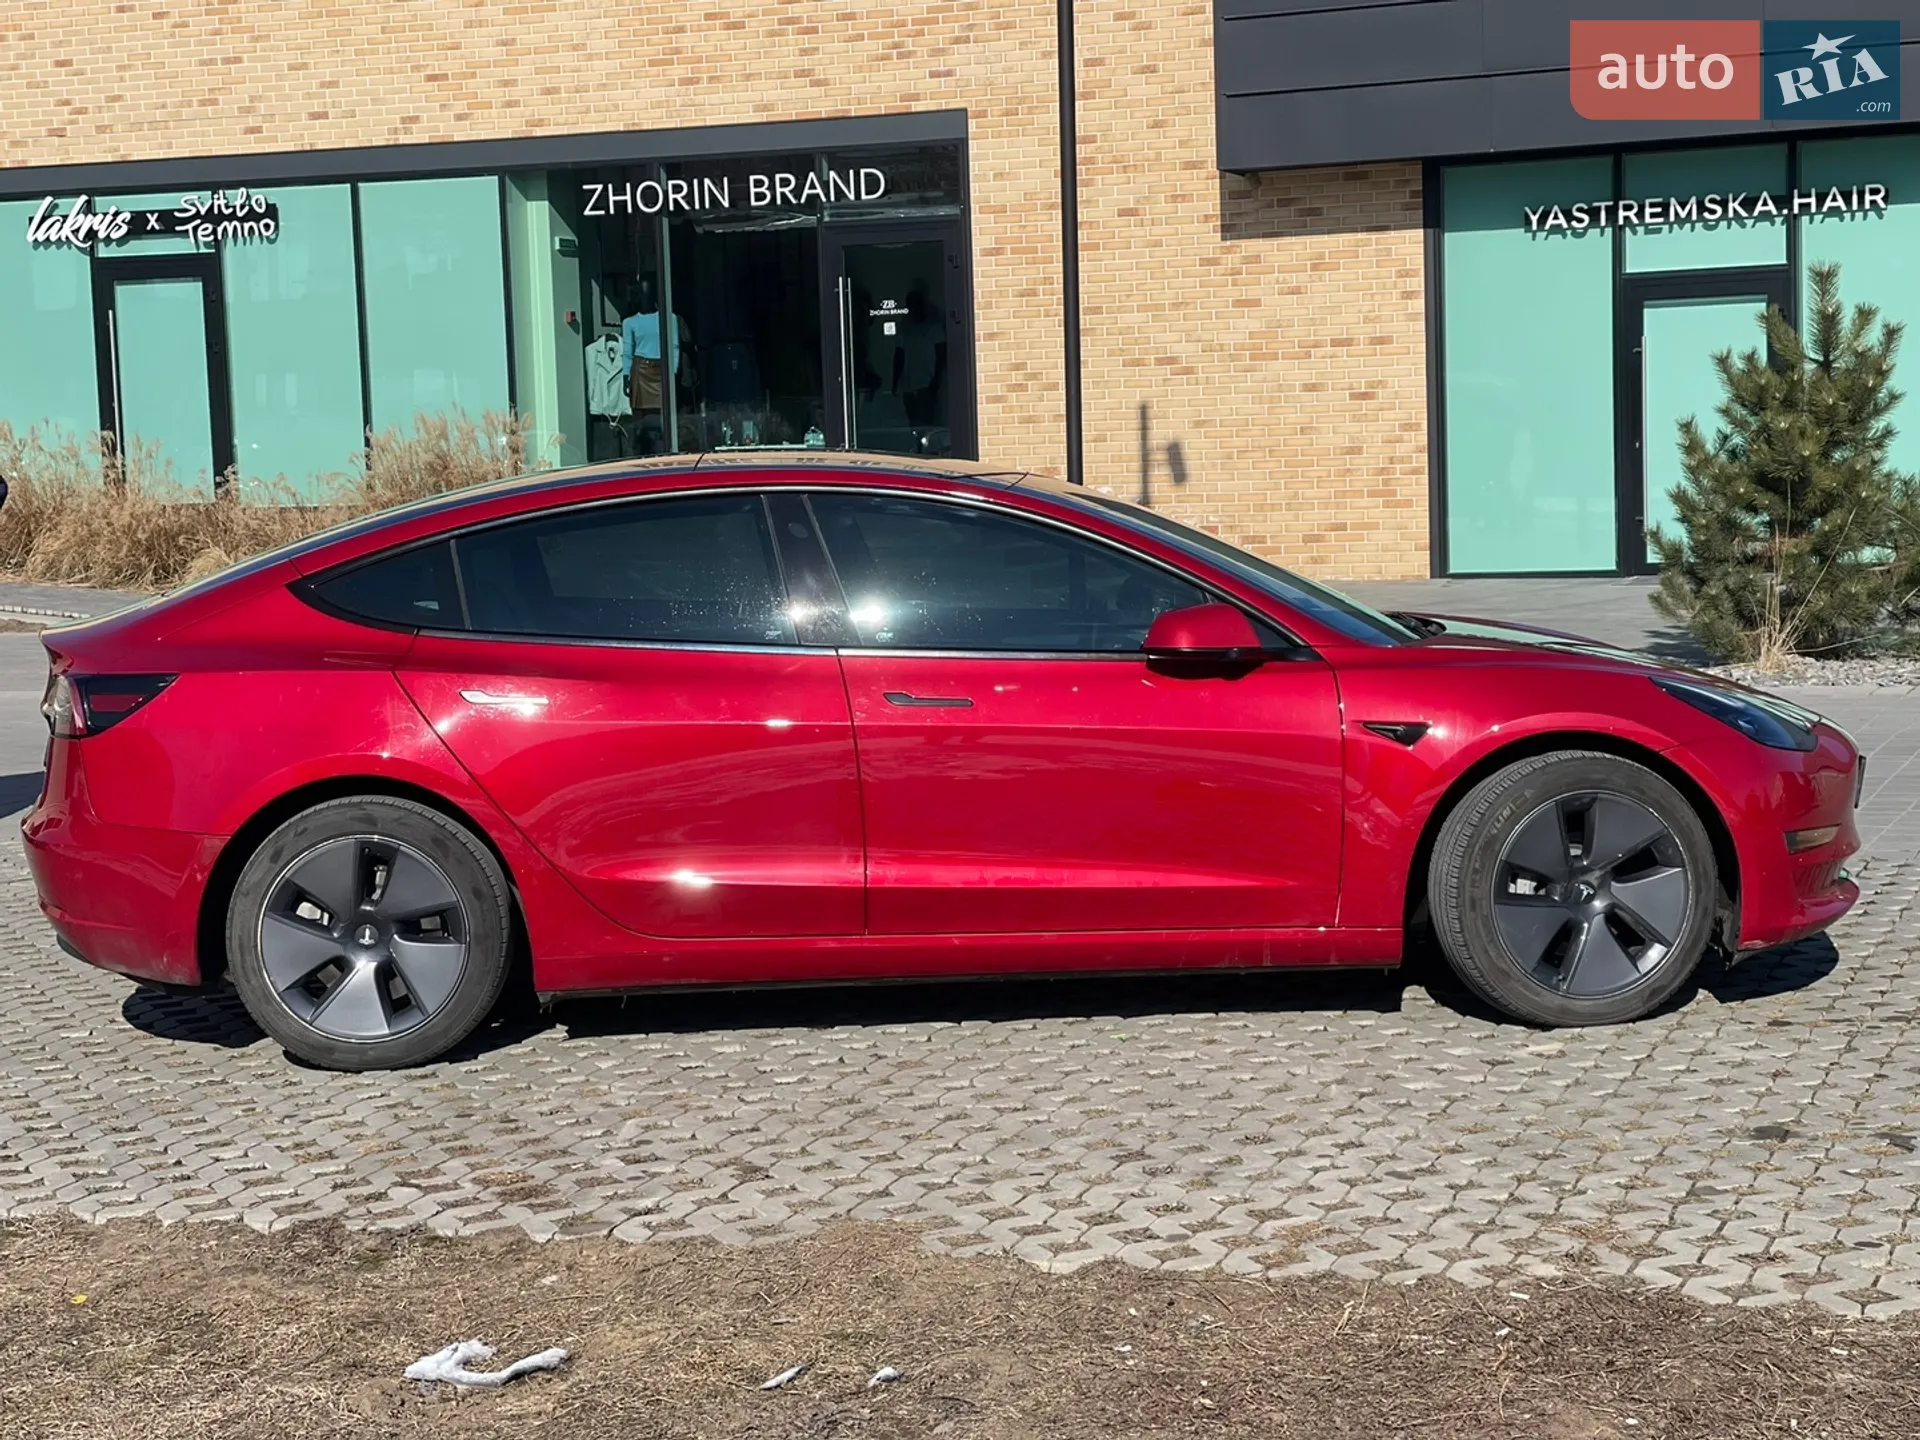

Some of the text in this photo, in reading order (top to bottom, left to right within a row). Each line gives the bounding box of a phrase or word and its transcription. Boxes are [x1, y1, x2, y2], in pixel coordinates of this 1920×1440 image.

[582, 168, 886, 216] ZHORIN BRAND
[1524, 183, 1888, 231] YASTREMSKA.HAIR
